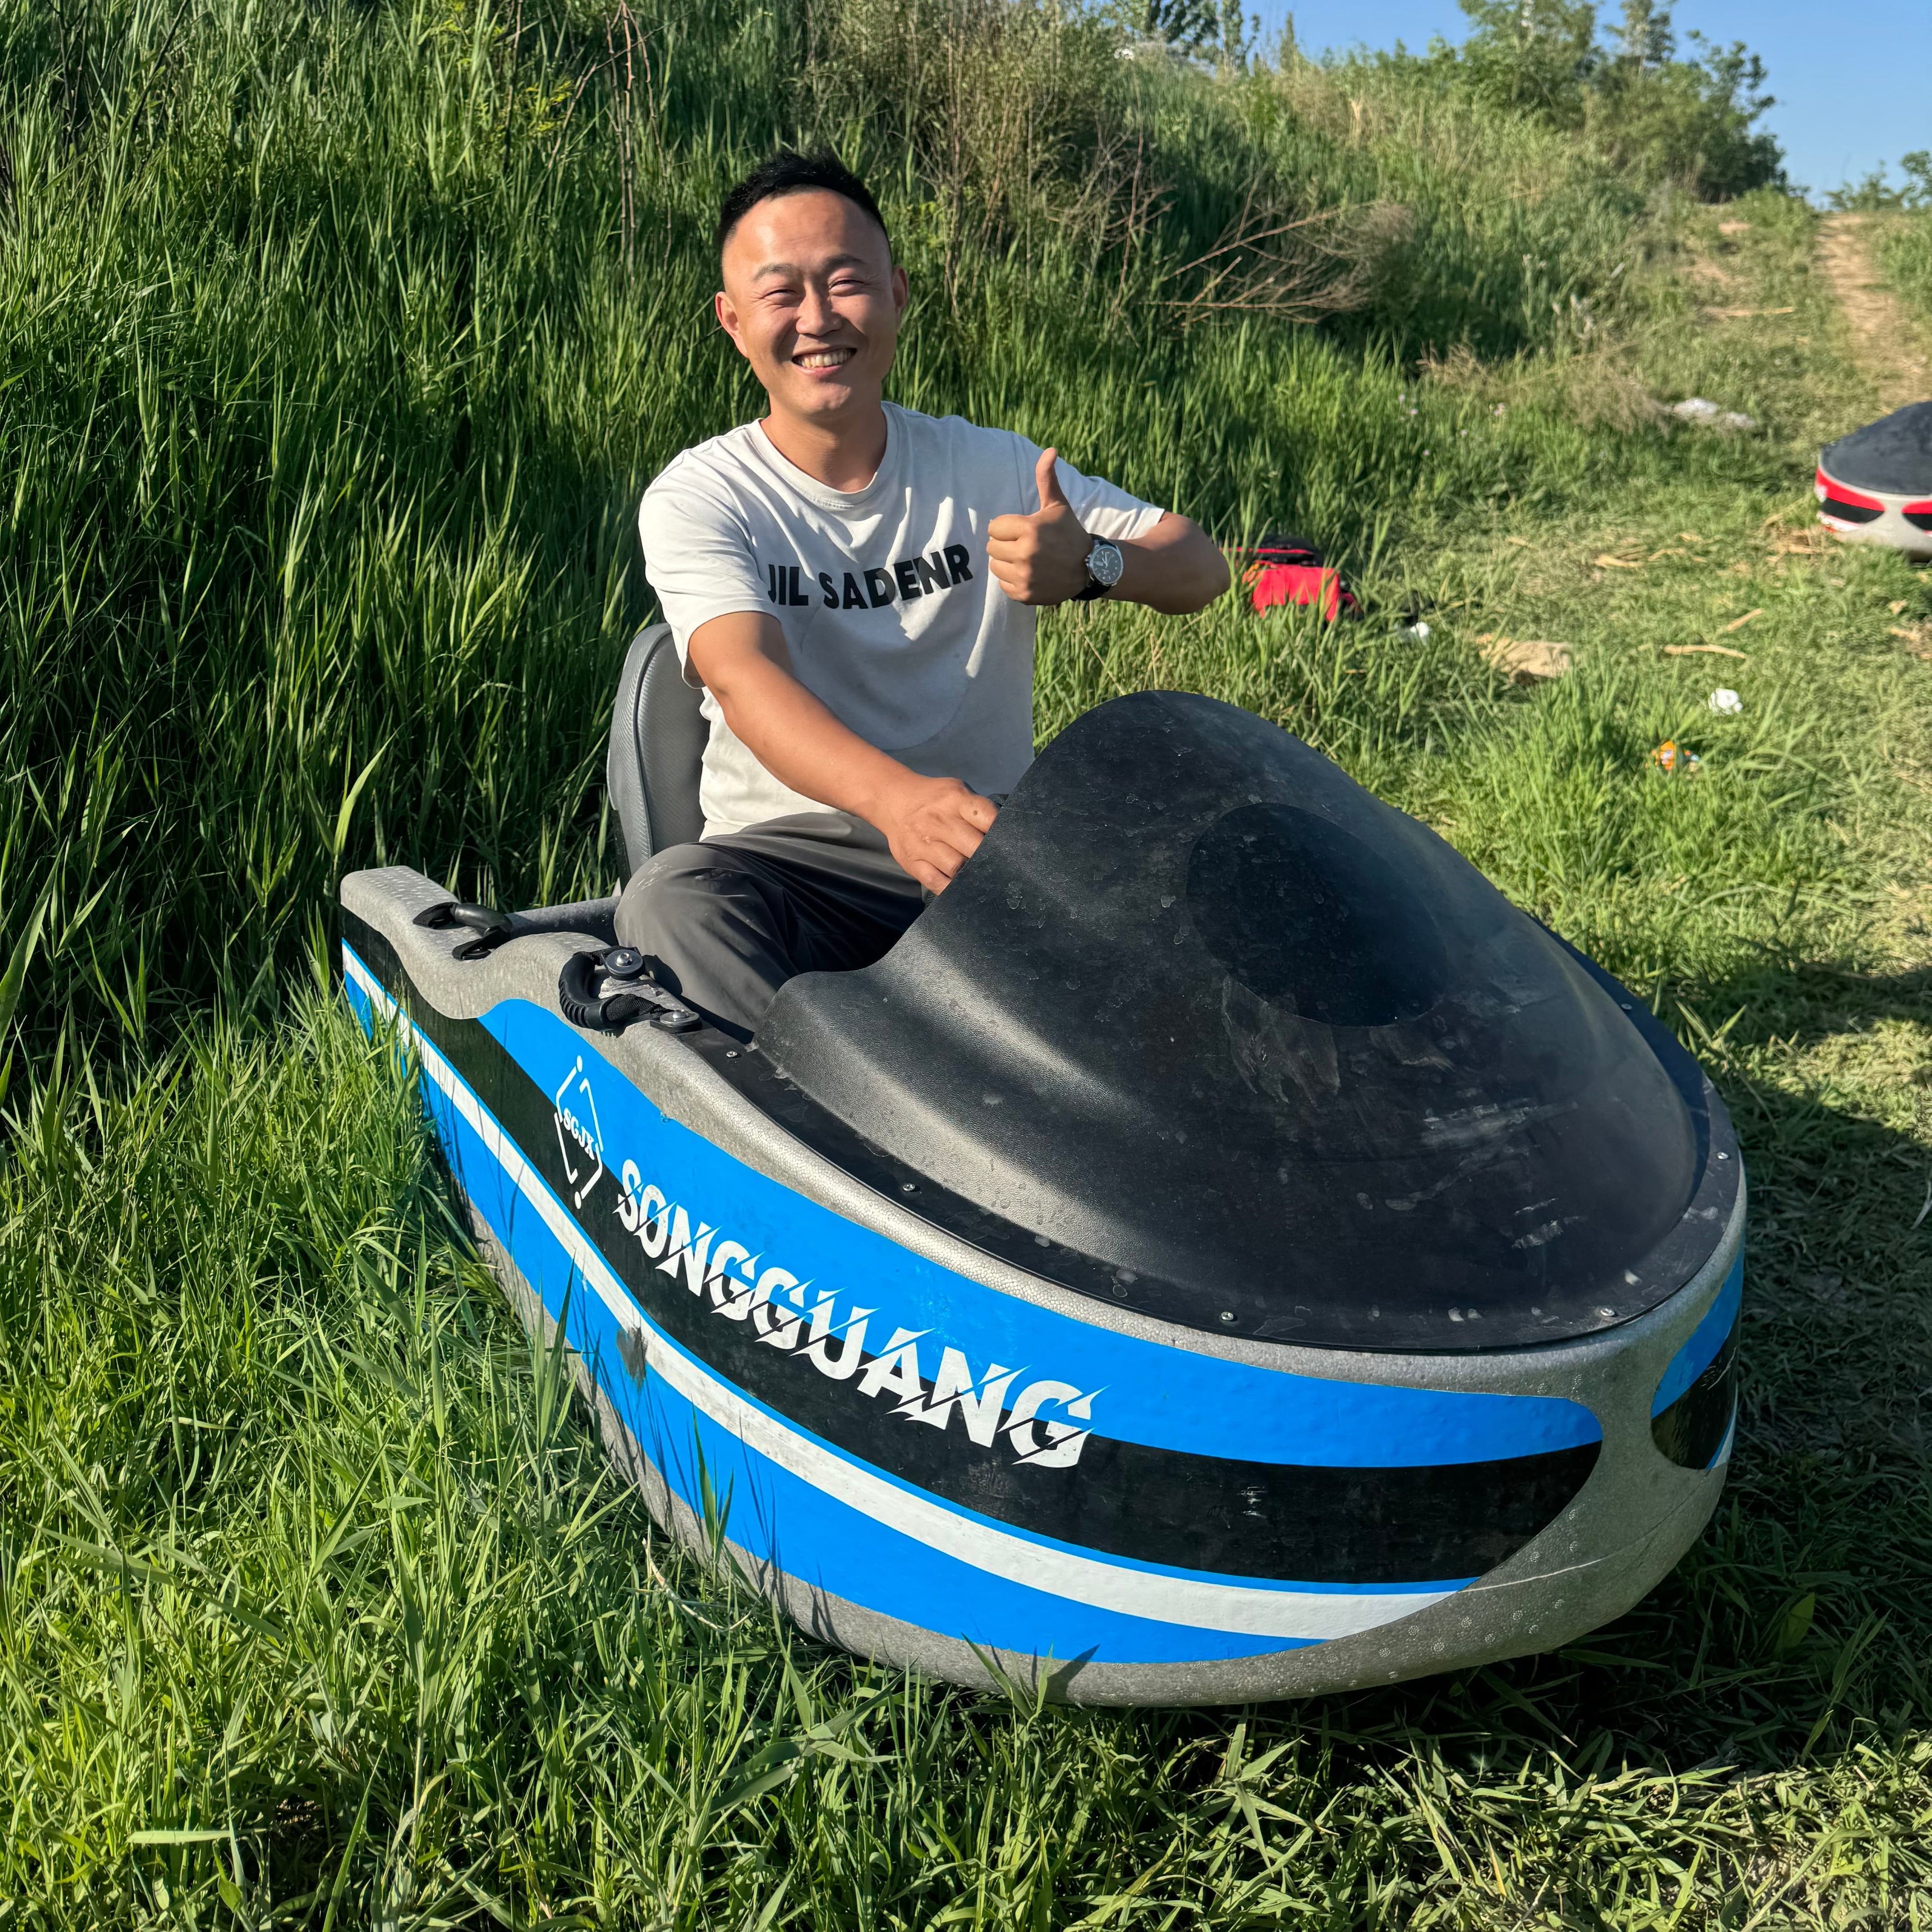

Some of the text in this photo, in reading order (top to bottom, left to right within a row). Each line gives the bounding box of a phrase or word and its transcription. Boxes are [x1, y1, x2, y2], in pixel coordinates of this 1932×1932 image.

[768, 544, 973, 609] JIL SADENR
[564, 1107, 595, 1160] SGJX
[612, 1159, 1110, 1468] SONGGUANG
